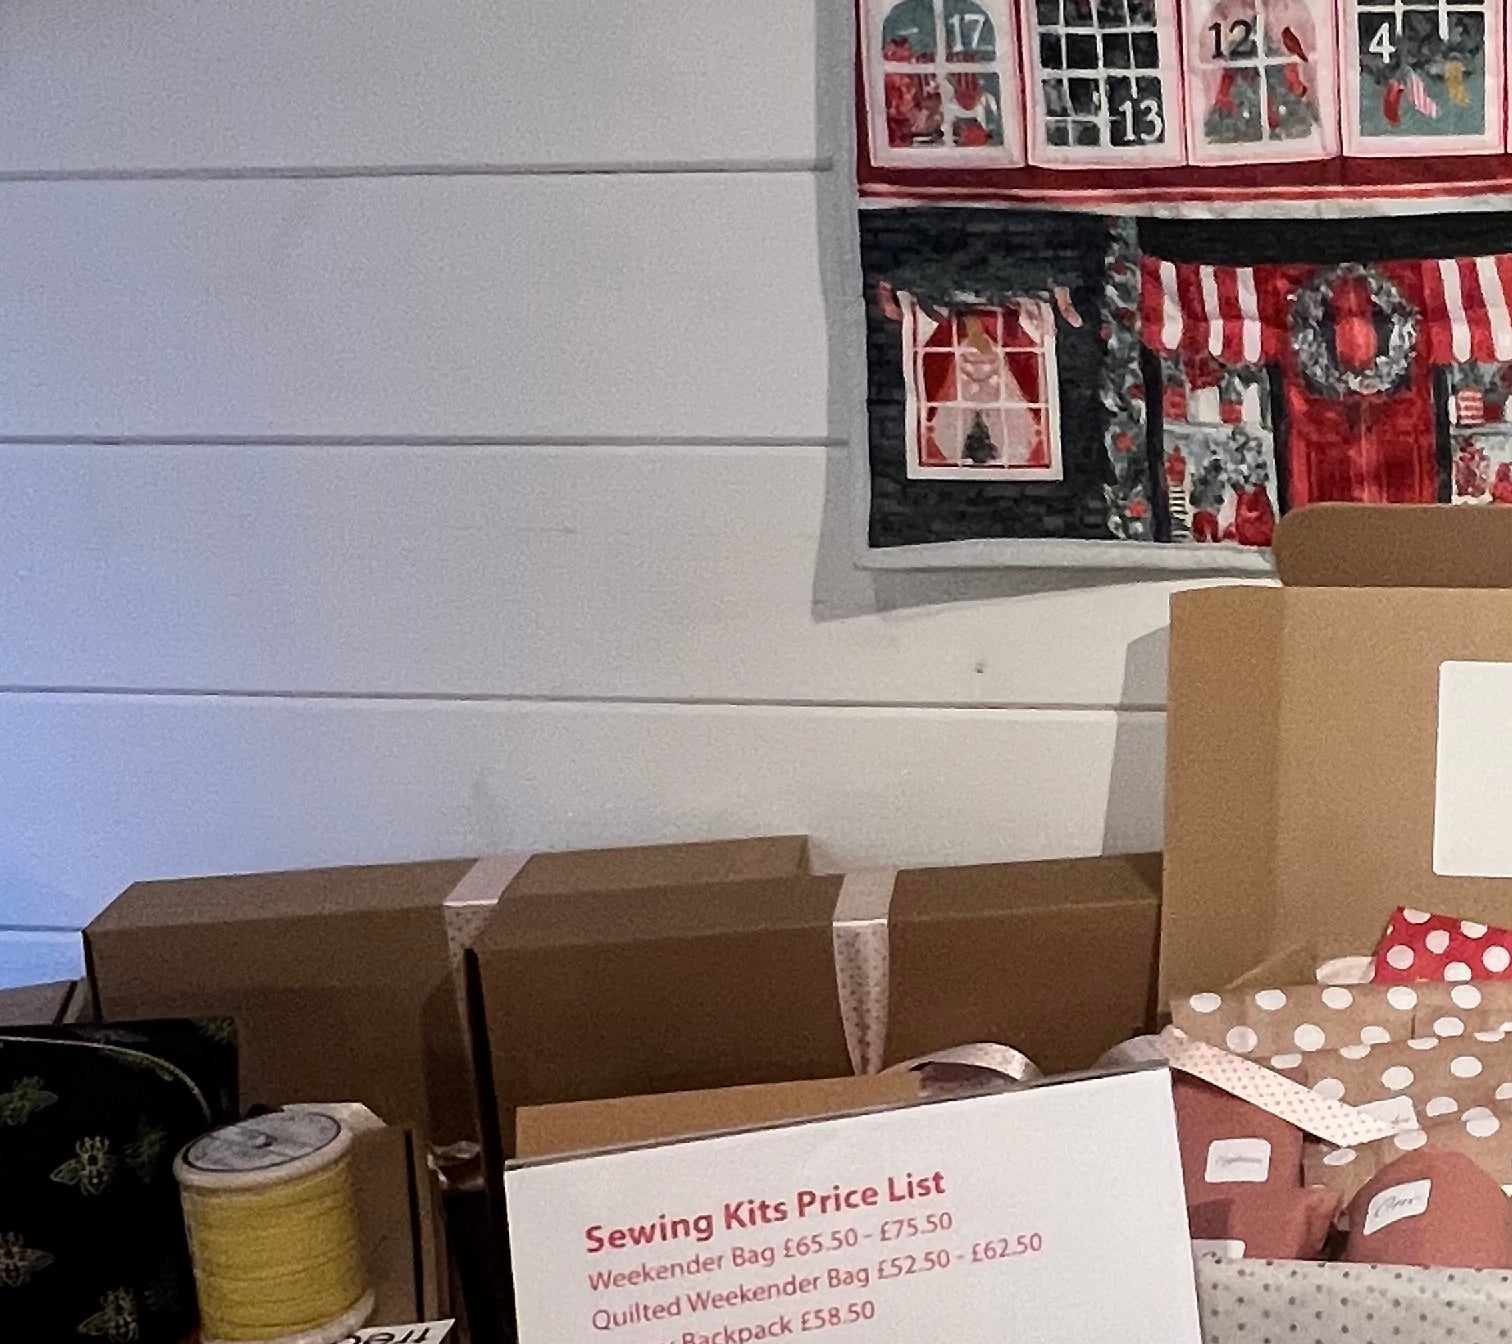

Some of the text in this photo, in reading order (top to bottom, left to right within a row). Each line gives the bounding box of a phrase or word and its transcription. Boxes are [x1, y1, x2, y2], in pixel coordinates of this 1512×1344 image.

[947, 12, 985, 53] 17
[1208, 17, 1258, 60] 12
[1367, 22, 1397, 63] 4
[1119, 100, 1165, 143] 13
[585, 1170, 946, 1253] Sewing Kits Price List
[588, 1253, 723, 1292] Weekender
[731, 1245, 776, 1267] Bag
[784, 1227, 859, 1257] £65.50
[879, 1211, 953, 1242] £75.50
[592, 1297, 681, 1331] Quilted
[687, 1273, 822, 1313] Weekender
[827, 1267, 870, 1289] Bag
[877, 1248, 951, 1280] £52.50
[971, 1232, 1043, 1263] £62.50
[800, 1300, 876, 1332] £58.50
